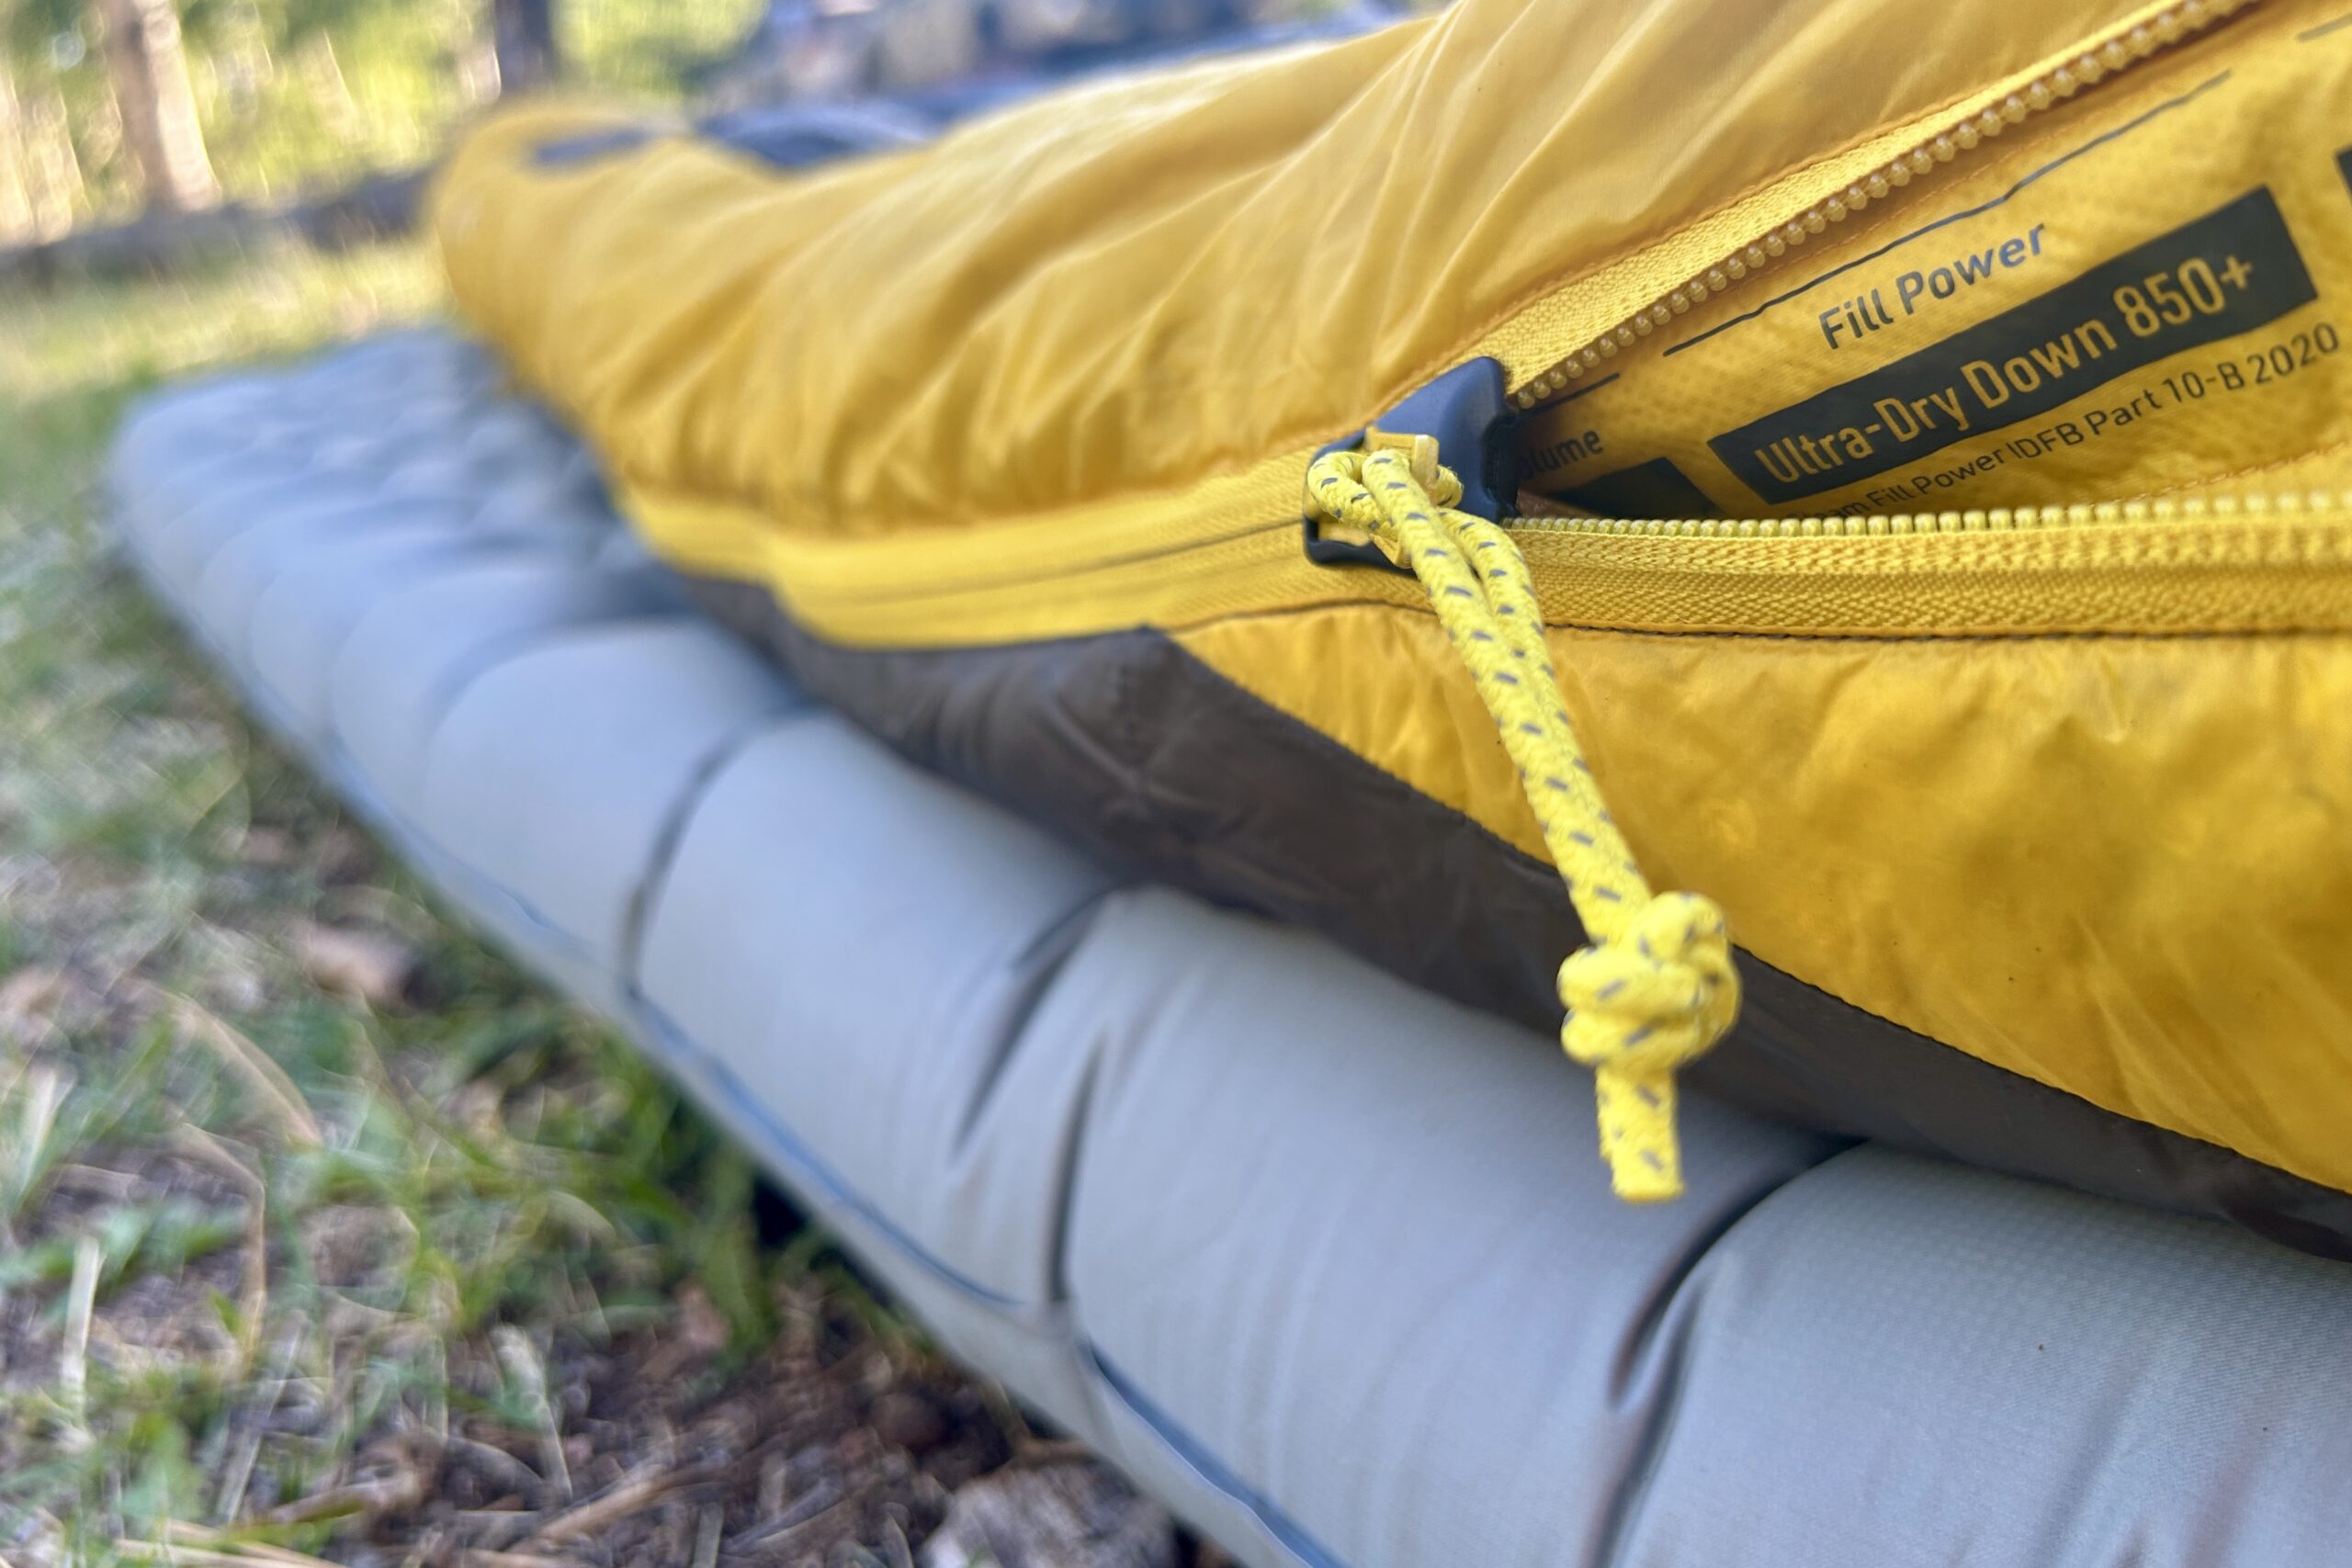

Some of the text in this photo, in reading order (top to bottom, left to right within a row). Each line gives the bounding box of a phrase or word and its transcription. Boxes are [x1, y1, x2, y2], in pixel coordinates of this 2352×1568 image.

[1818, 222, 2045, 350] Fill Power
[1754, 254, 2254, 484] Ultra-Dry Down 850+
[1865, 321, 2341, 508] Fill Power IDFB Part 10-B 2020
[1516, 430, 1604, 479] olume
